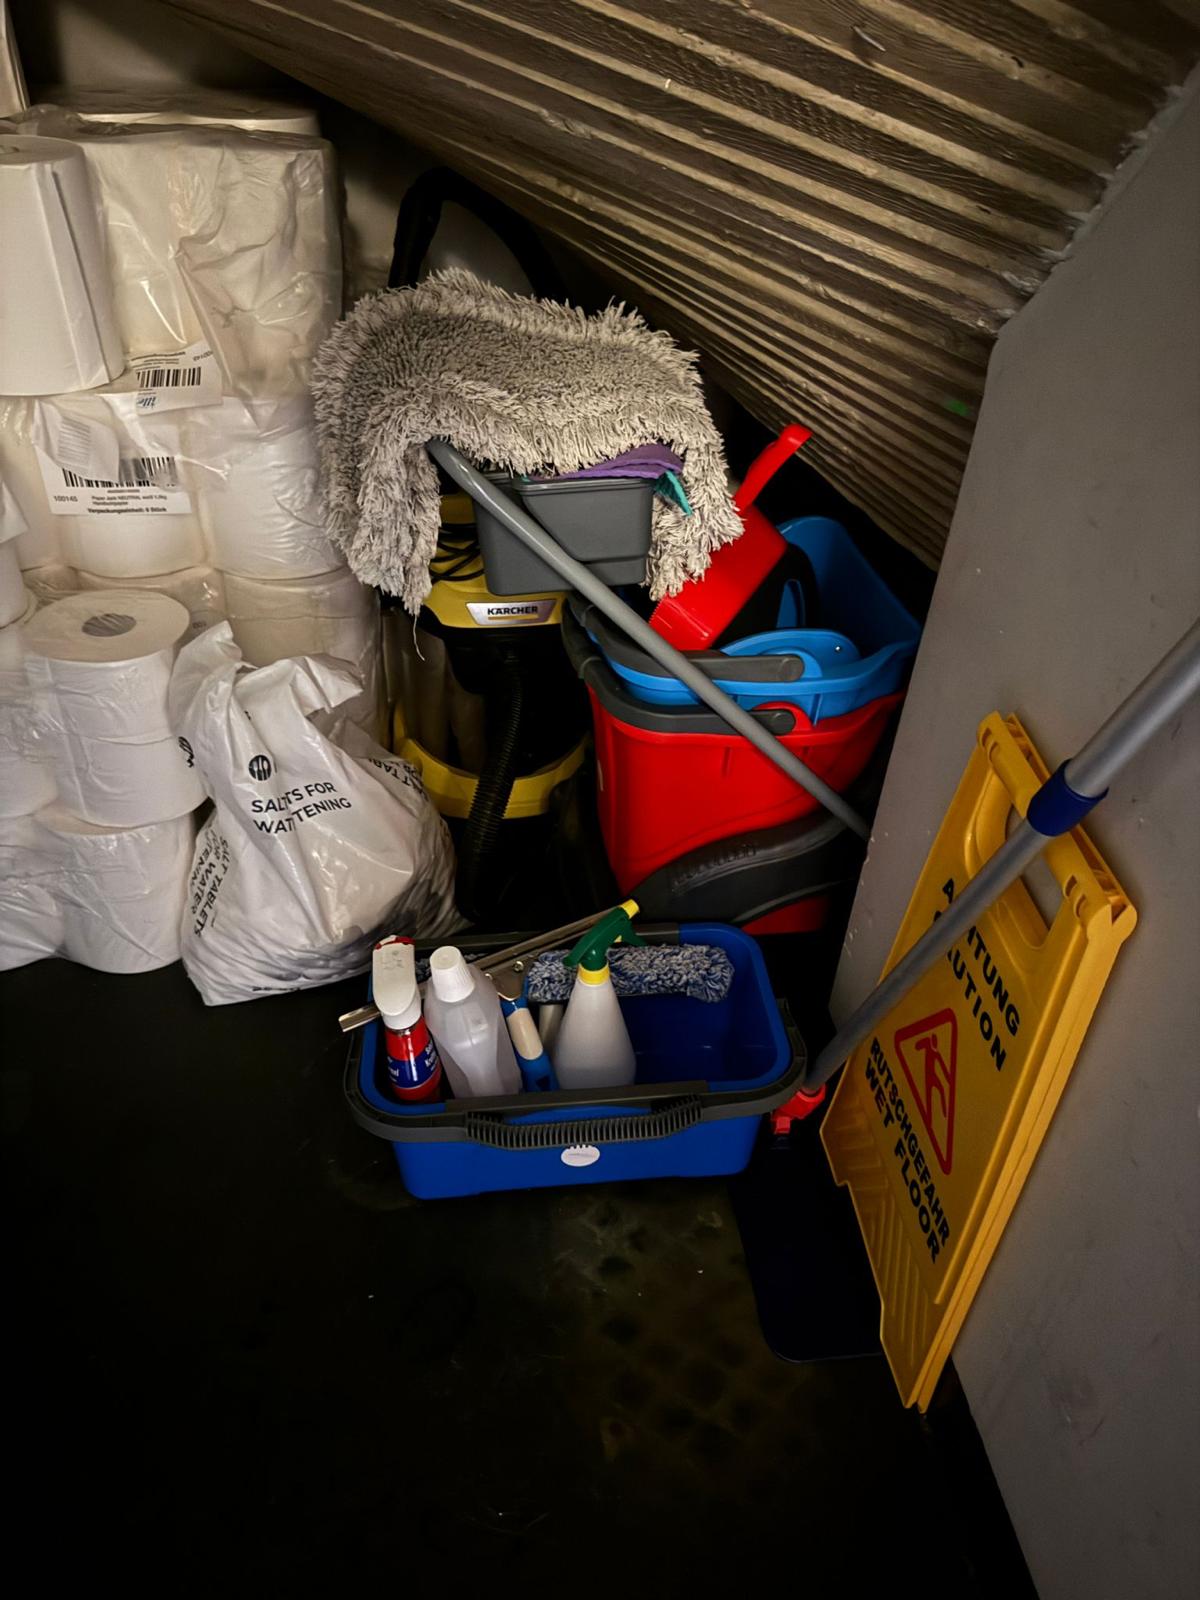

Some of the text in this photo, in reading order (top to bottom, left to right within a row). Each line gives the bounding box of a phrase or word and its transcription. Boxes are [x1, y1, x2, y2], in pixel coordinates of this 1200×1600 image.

[303, 781, 337, 798] FOR
[194, 873, 223, 938] TABLETS
[942, 878, 1021, 1036] ATUNG
[934, 910, 1007, 1071] UTION
[865, 1058, 940, 1263] WET FLOOR
[870, 1037, 950, 1247] RUTSCHGEFAHR
